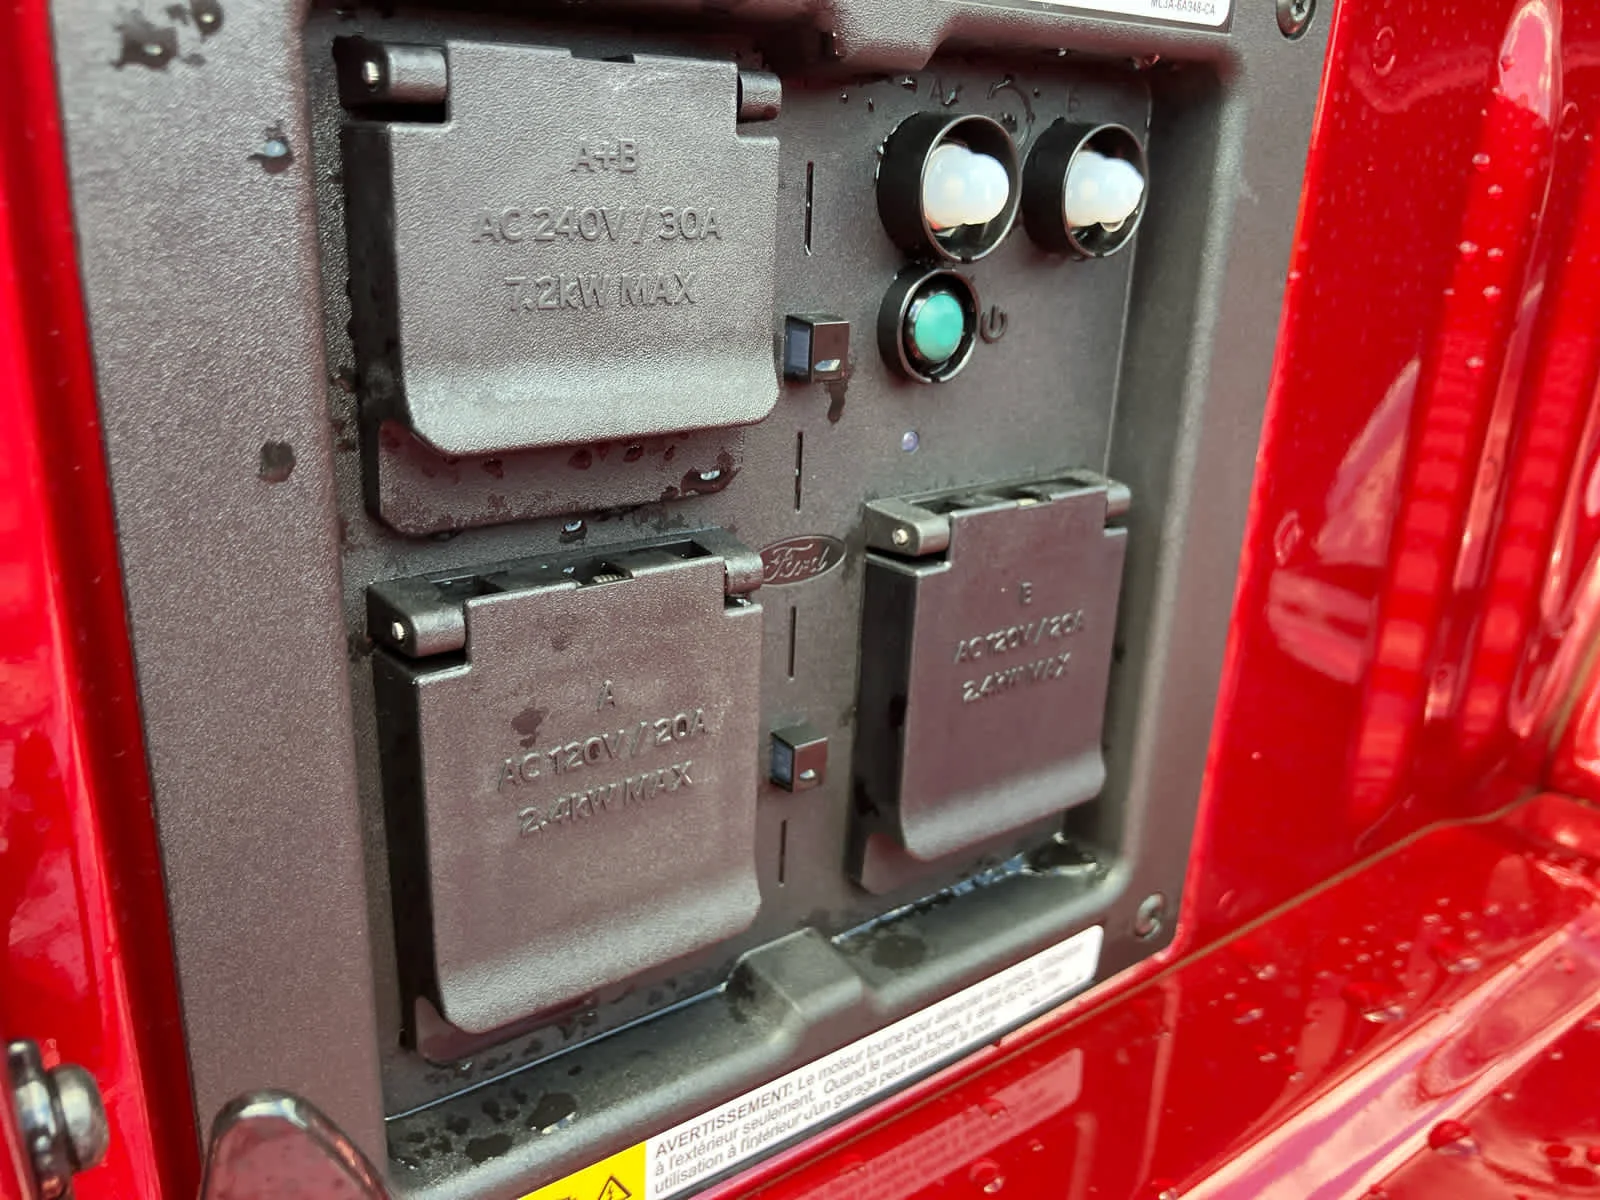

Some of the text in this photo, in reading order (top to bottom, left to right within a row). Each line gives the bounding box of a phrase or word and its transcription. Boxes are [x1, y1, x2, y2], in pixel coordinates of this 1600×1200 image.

[570, 137, 640, 173] A+B
[472, 205, 721, 244] AC 240V / 30A
[503, 271, 697, 312] 7.2kW MAX
[764, 543, 830, 582] Ford
[597, 680, 615, 712] A
[497, 708, 707, 791] AC 120V / 20A
[518, 760, 693, 836] 2.4kW MAX
[655, 1082, 794, 1159] AVERTISSEMENT:
[798, 1073, 815, 1091] Le
[818, 1050, 865, 1081] moteur
[655, 1160, 665, 1176] à
[823, 1063, 867, 1095] Quand
[655, 1152, 723, 1194] utilisation
[727, 1144, 737, 1159] à
[834, 1074, 877, 1109] garage
